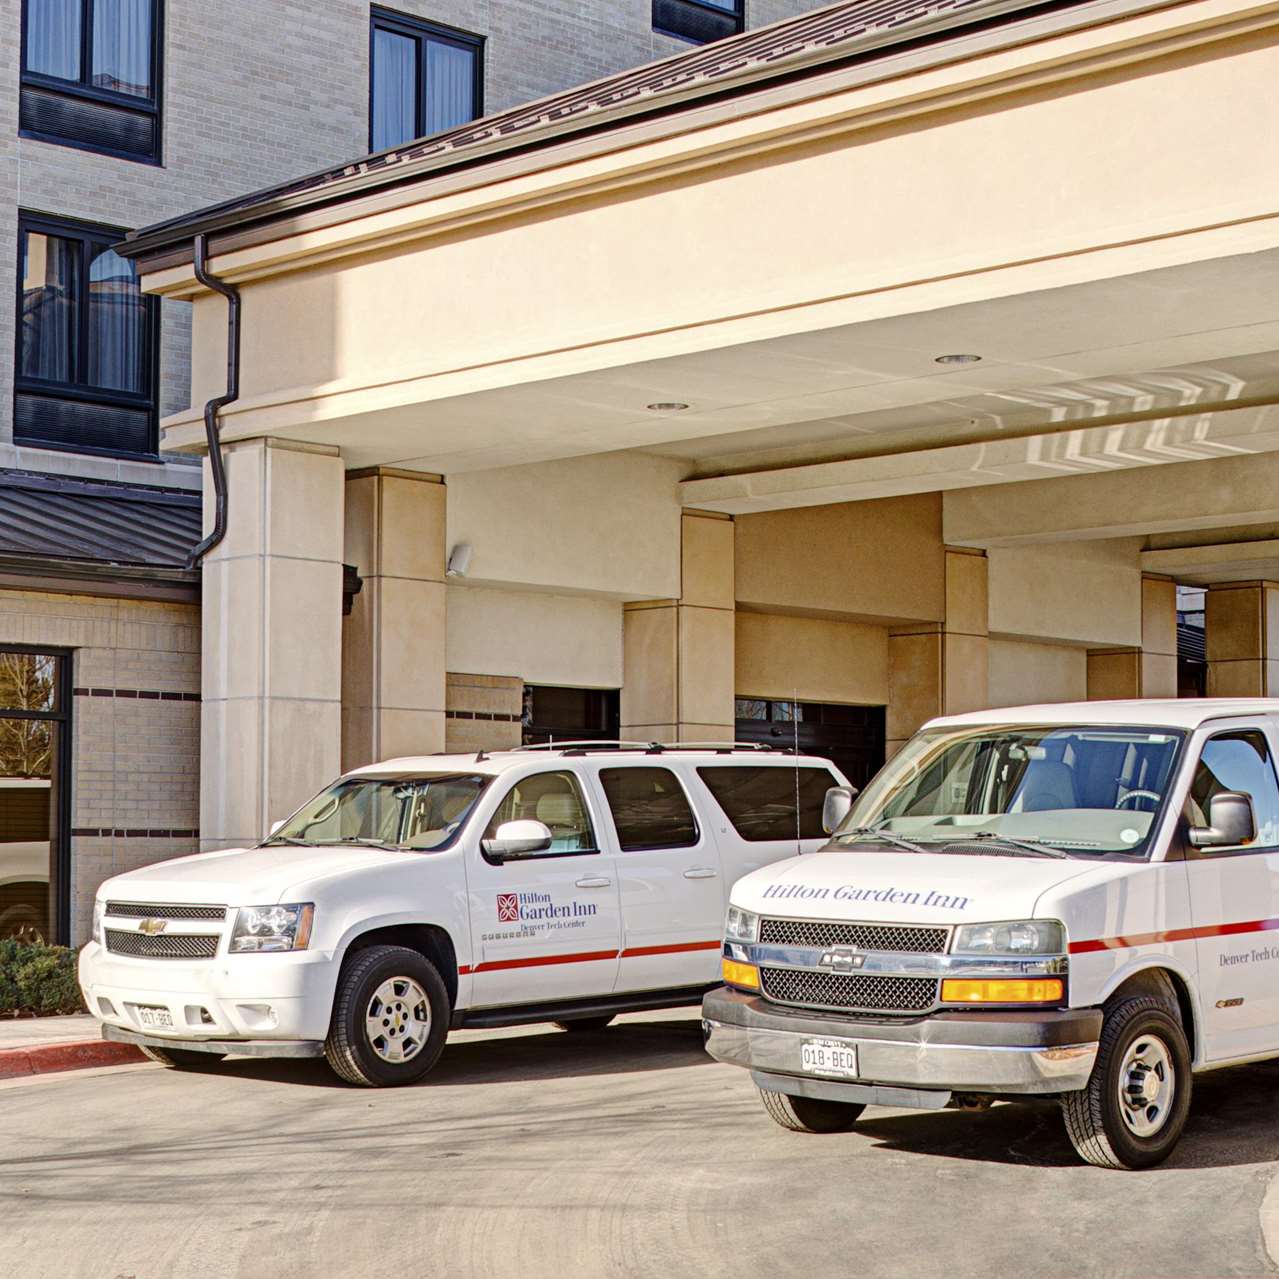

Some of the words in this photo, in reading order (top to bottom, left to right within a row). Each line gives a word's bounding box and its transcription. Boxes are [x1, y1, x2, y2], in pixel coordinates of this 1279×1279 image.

[519, 893, 551, 904] Hilton
[762, 885, 830, 899] Hilton
[833, 885, 920, 905] Garden
[923, 890, 970, 910] Inn
[520, 903, 570, 920] Garden
[573, 901, 597, 916] Inn
[1219, 953, 1249, 967] Denver
[1251, 946, 1270, 962] Tech
